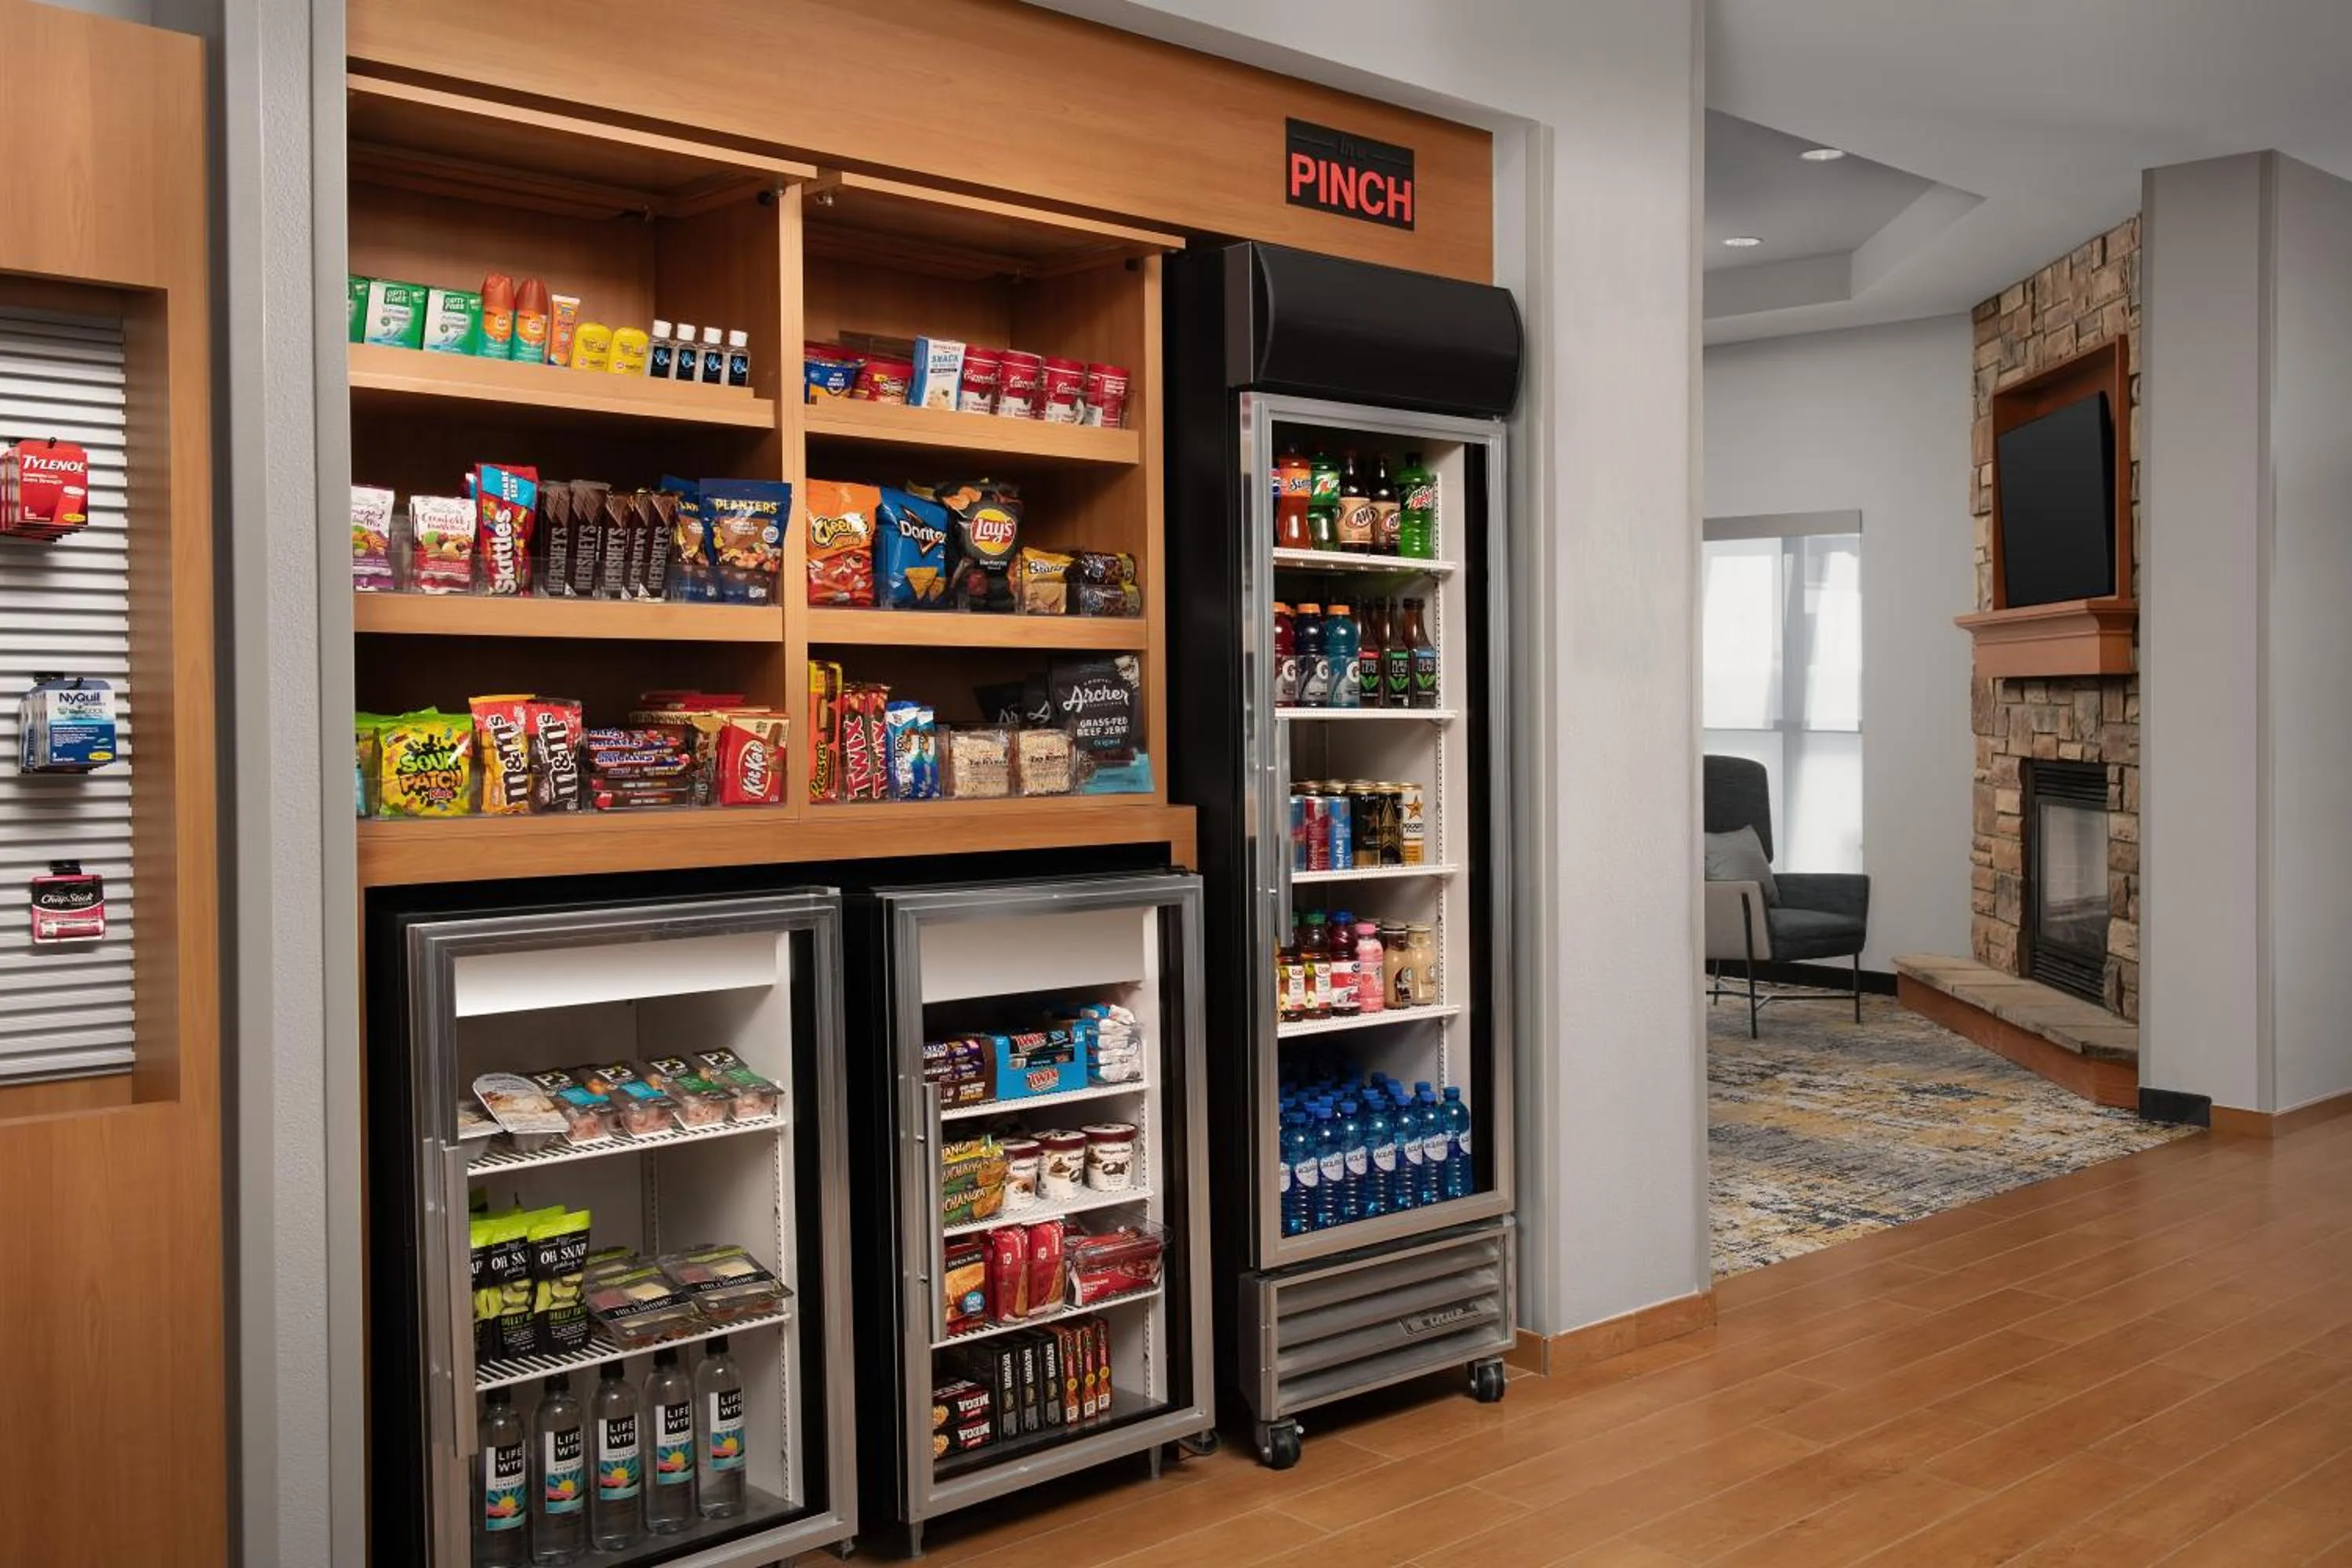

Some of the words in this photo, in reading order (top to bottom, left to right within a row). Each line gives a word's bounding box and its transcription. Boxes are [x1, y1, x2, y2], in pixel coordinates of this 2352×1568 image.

[1291, 152, 1412, 222] PINCH
[22, 455, 85, 473] TYLENOL
[714, 498, 779, 514] PLANTERS
[975, 517, 1014, 543] Lay's
[59, 692, 101, 704] NyQuil
[1062, 684, 1129, 713] Archer
[400, 750, 459, 773] SOUR
[398, 770, 464, 793] PATCH
[540, 1249, 557, 1265] OH
[720, 1392, 741, 1405] LIFE
[666, 1406, 689, 1418] LIFE
[609, 1420, 634, 1432] LIFE
[557, 1431, 581, 1445] LIFE
[609, 1432, 634, 1445] WTR
[499, 1446, 523, 1461] LIFE
